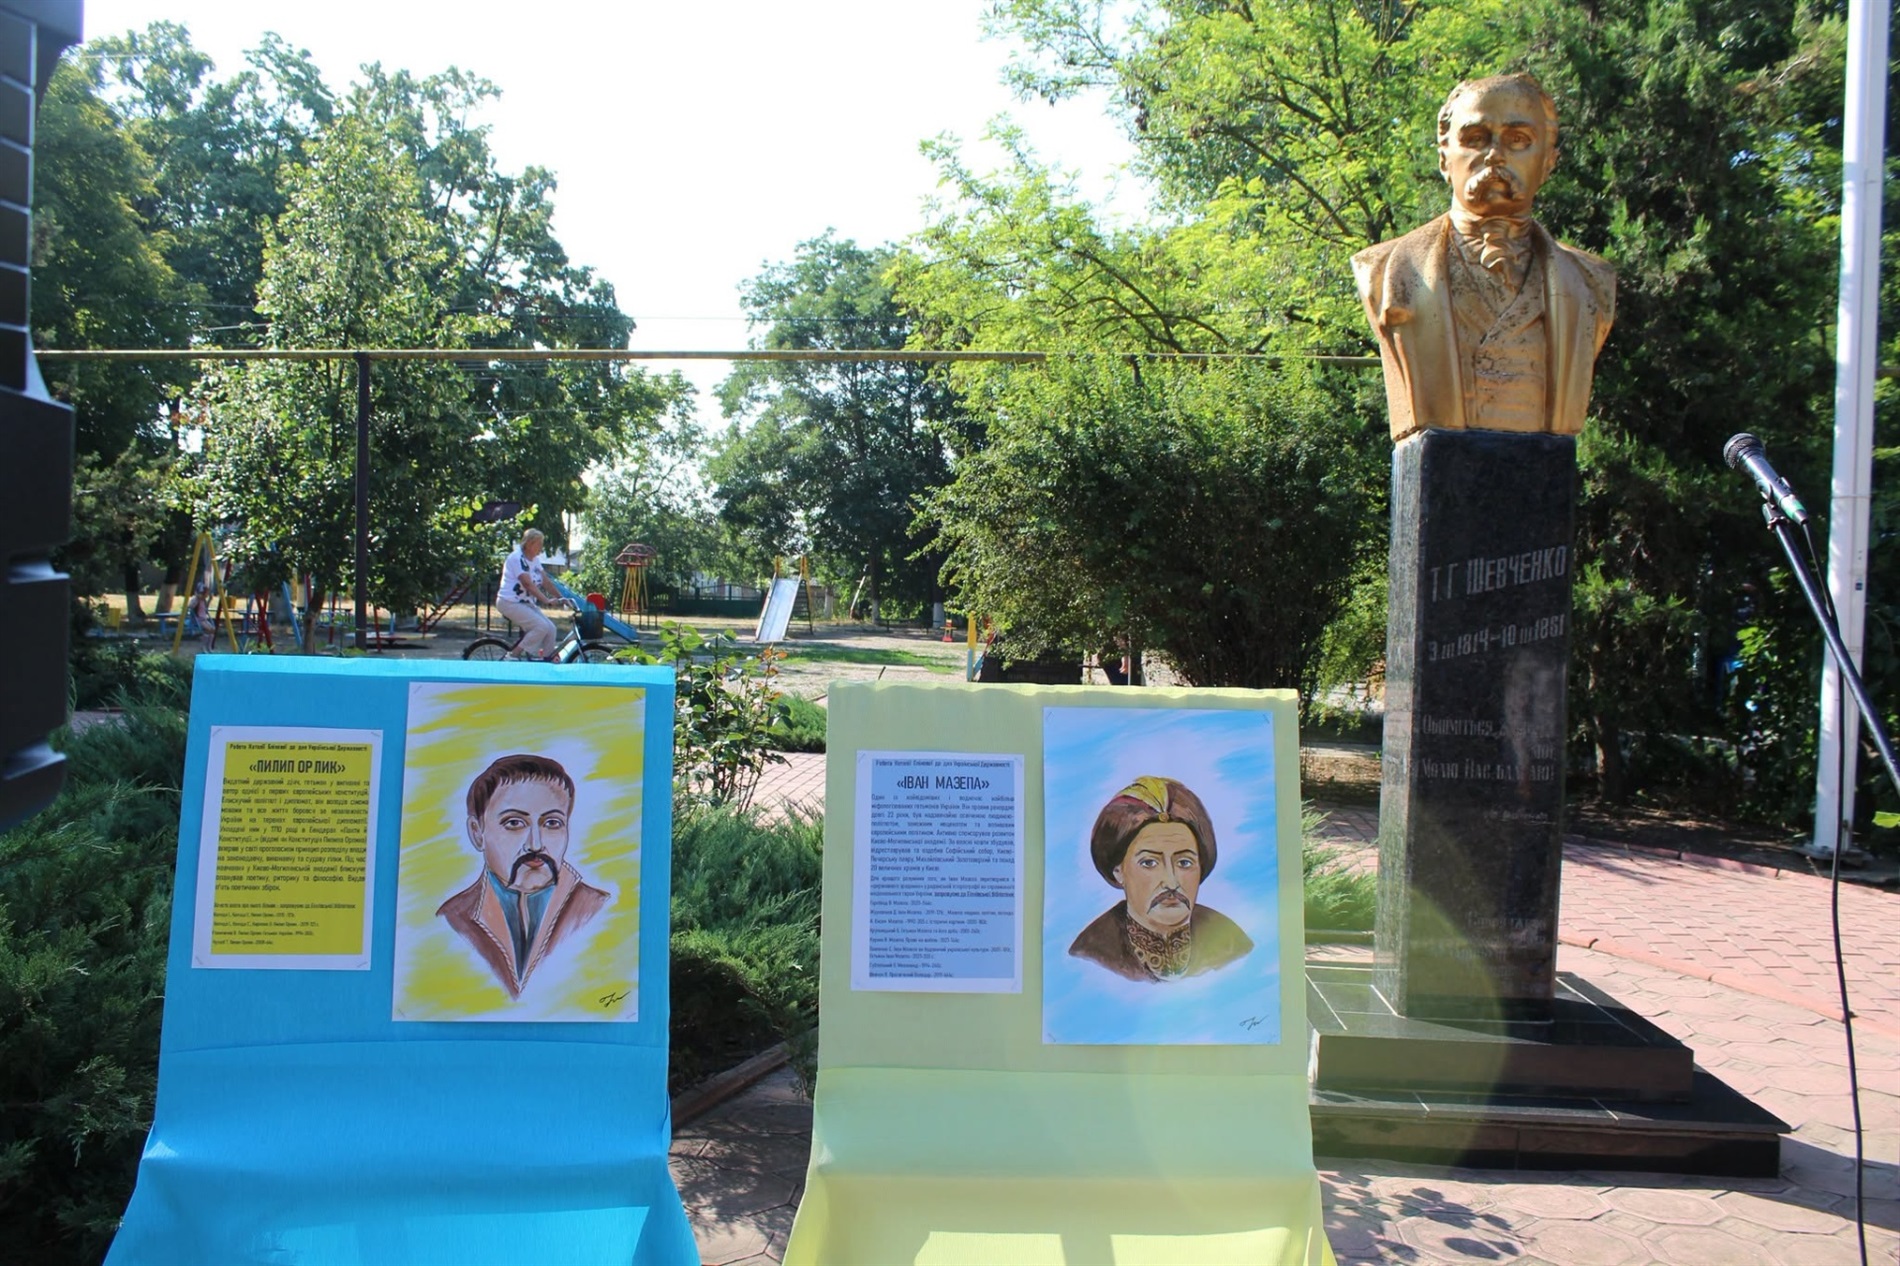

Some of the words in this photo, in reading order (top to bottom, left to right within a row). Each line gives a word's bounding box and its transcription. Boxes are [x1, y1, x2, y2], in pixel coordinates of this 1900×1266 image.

[1465, 545, 1567, 595] ШЕВЧЕНКО
[249, 759, 294, 773] «ПИЛИП
[297, 760, 345, 773] ОРЛИК»
[897, 775, 929, 789] «ІВАН
[935, 776, 989, 790] МАЗЕПА»
